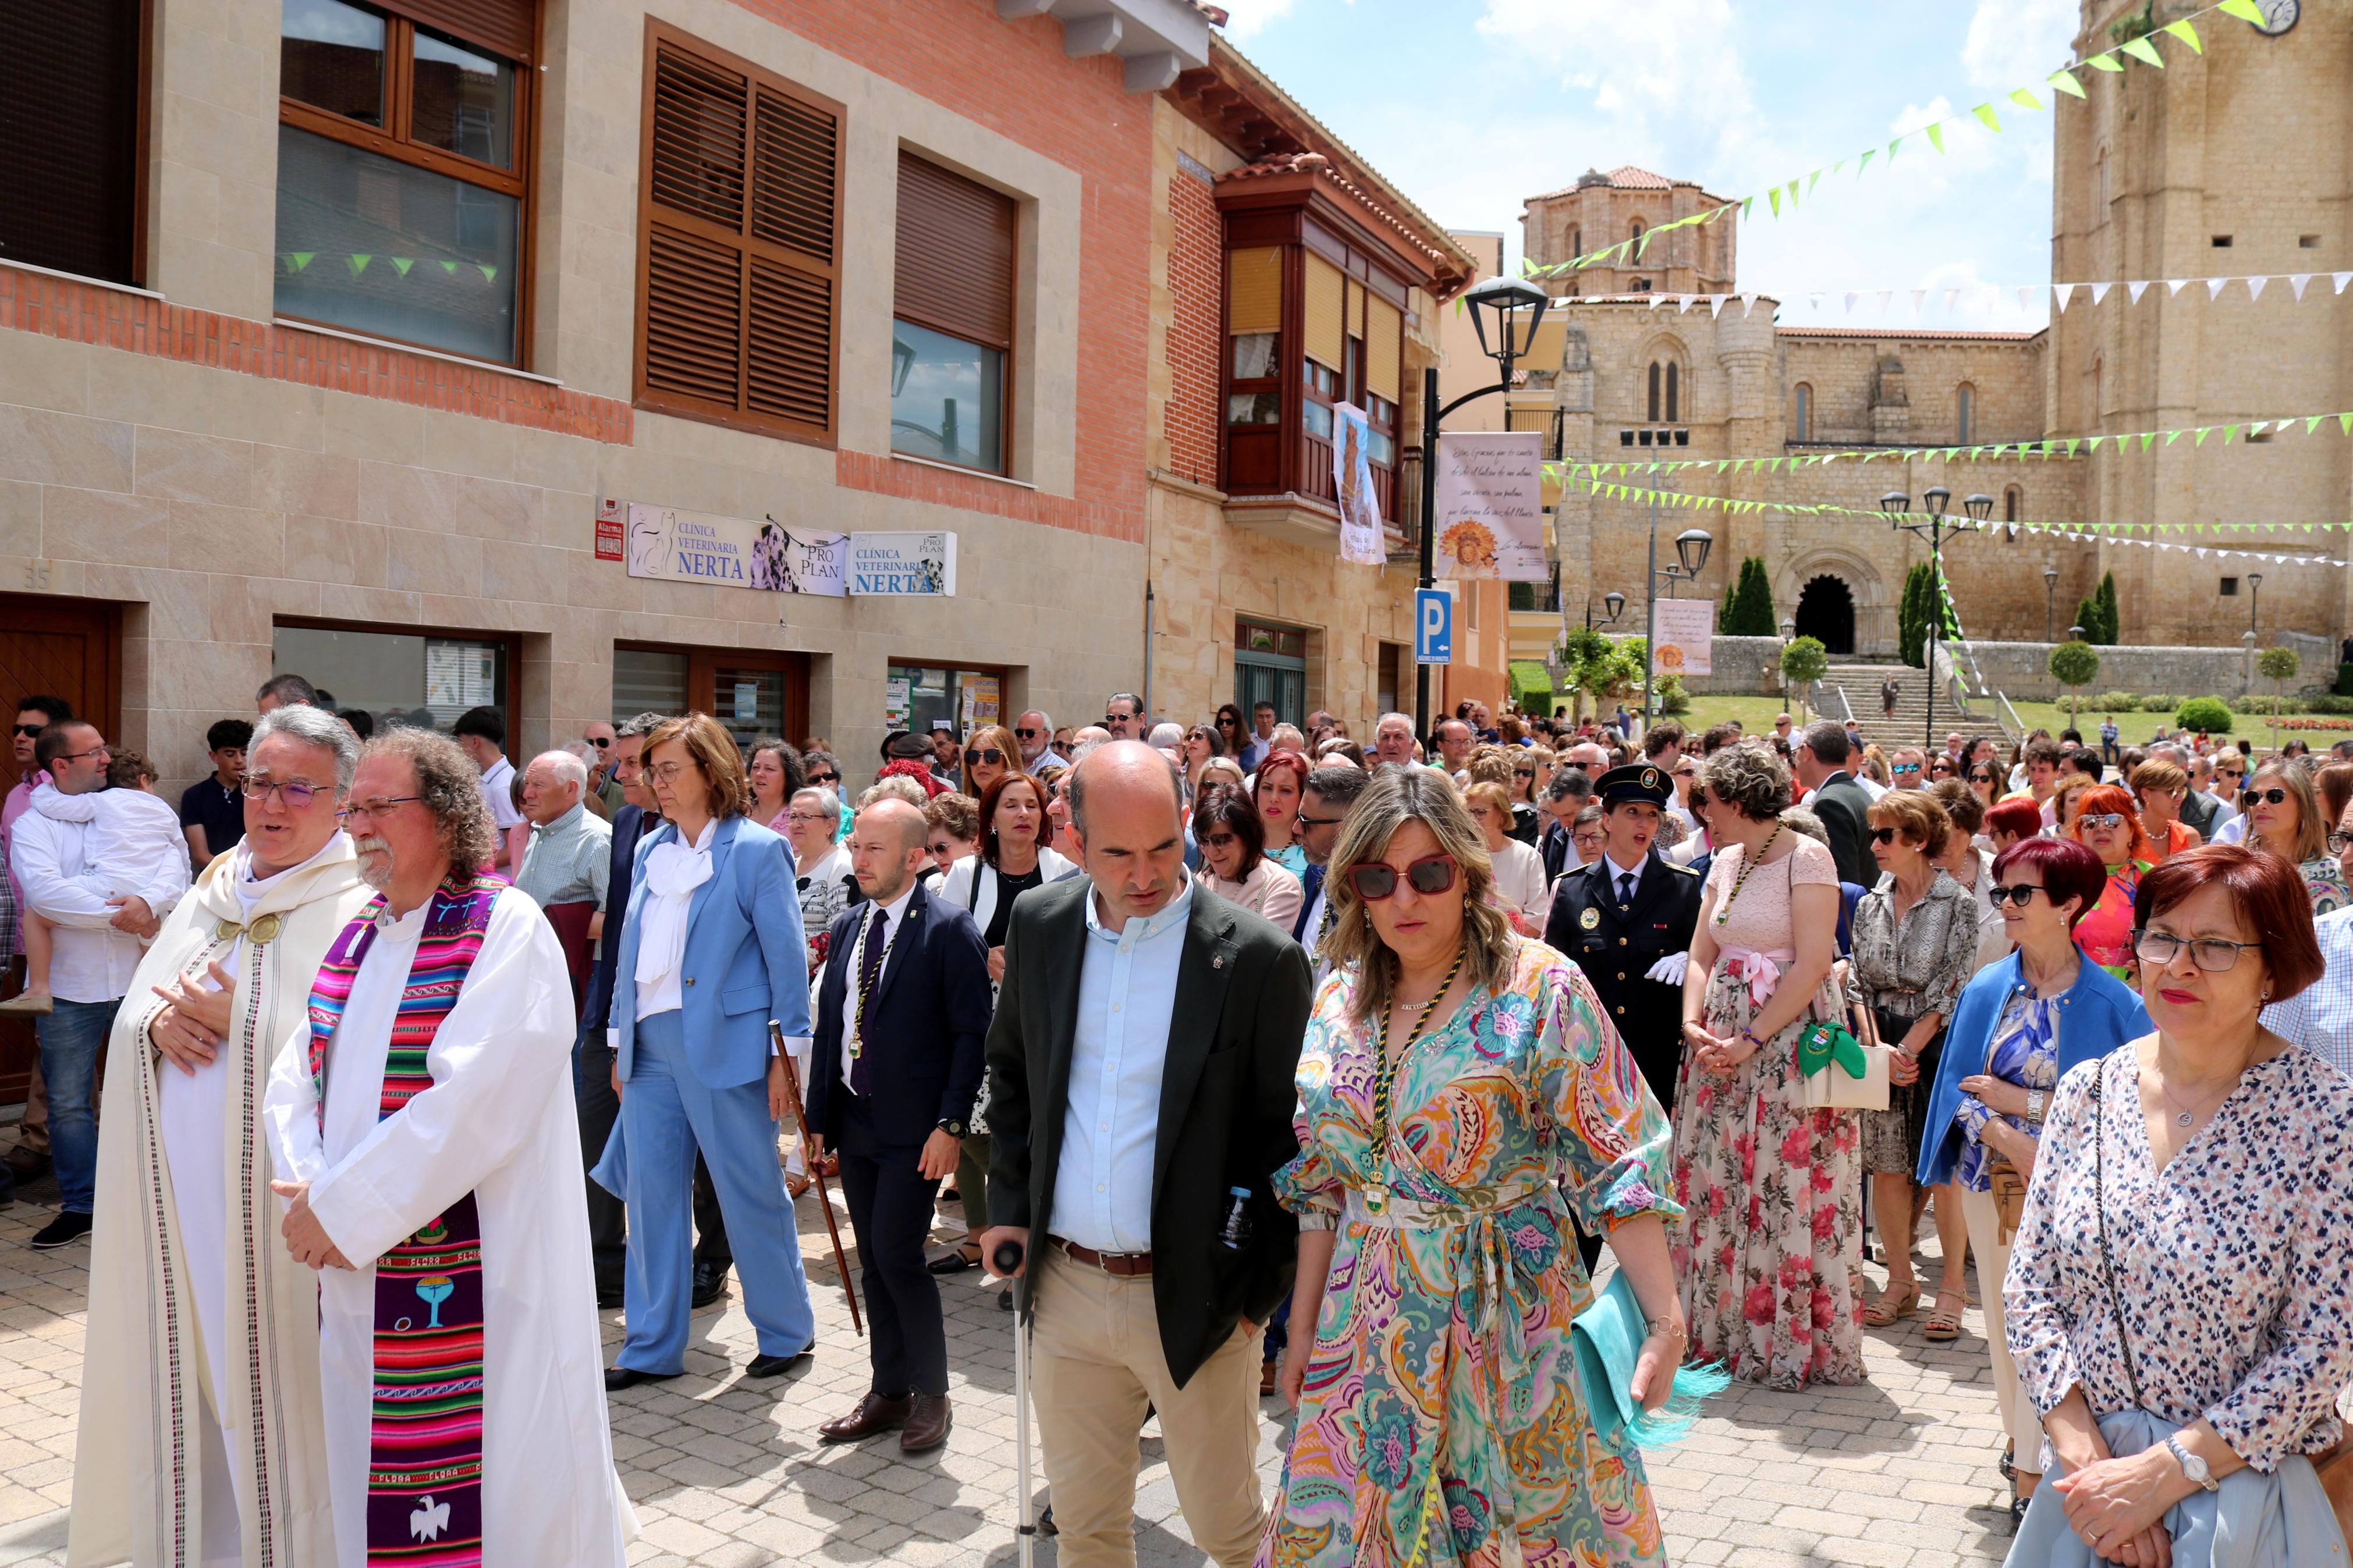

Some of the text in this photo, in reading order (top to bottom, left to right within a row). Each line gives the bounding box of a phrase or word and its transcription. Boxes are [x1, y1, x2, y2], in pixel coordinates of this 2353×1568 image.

[598, 522, 622, 533] Alarma
[679, 521, 716, 537] CLÍNICA
[678, 537, 737, 554] VETERINARIA
[808, 545, 833, 562] PRO
[856, 547, 900, 559] CLÍNICA
[677, 552, 744, 579] NERTA
[801, 560, 840, 578] PLAN
[856, 562, 928, 571] VETERINARIA
[854, 574, 934, 593] NERTA
[1423, 598, 1445, 655] P
[410, 1257, 440, 1266] FLORA
[429, 1469, 458, 1480] FLORA
